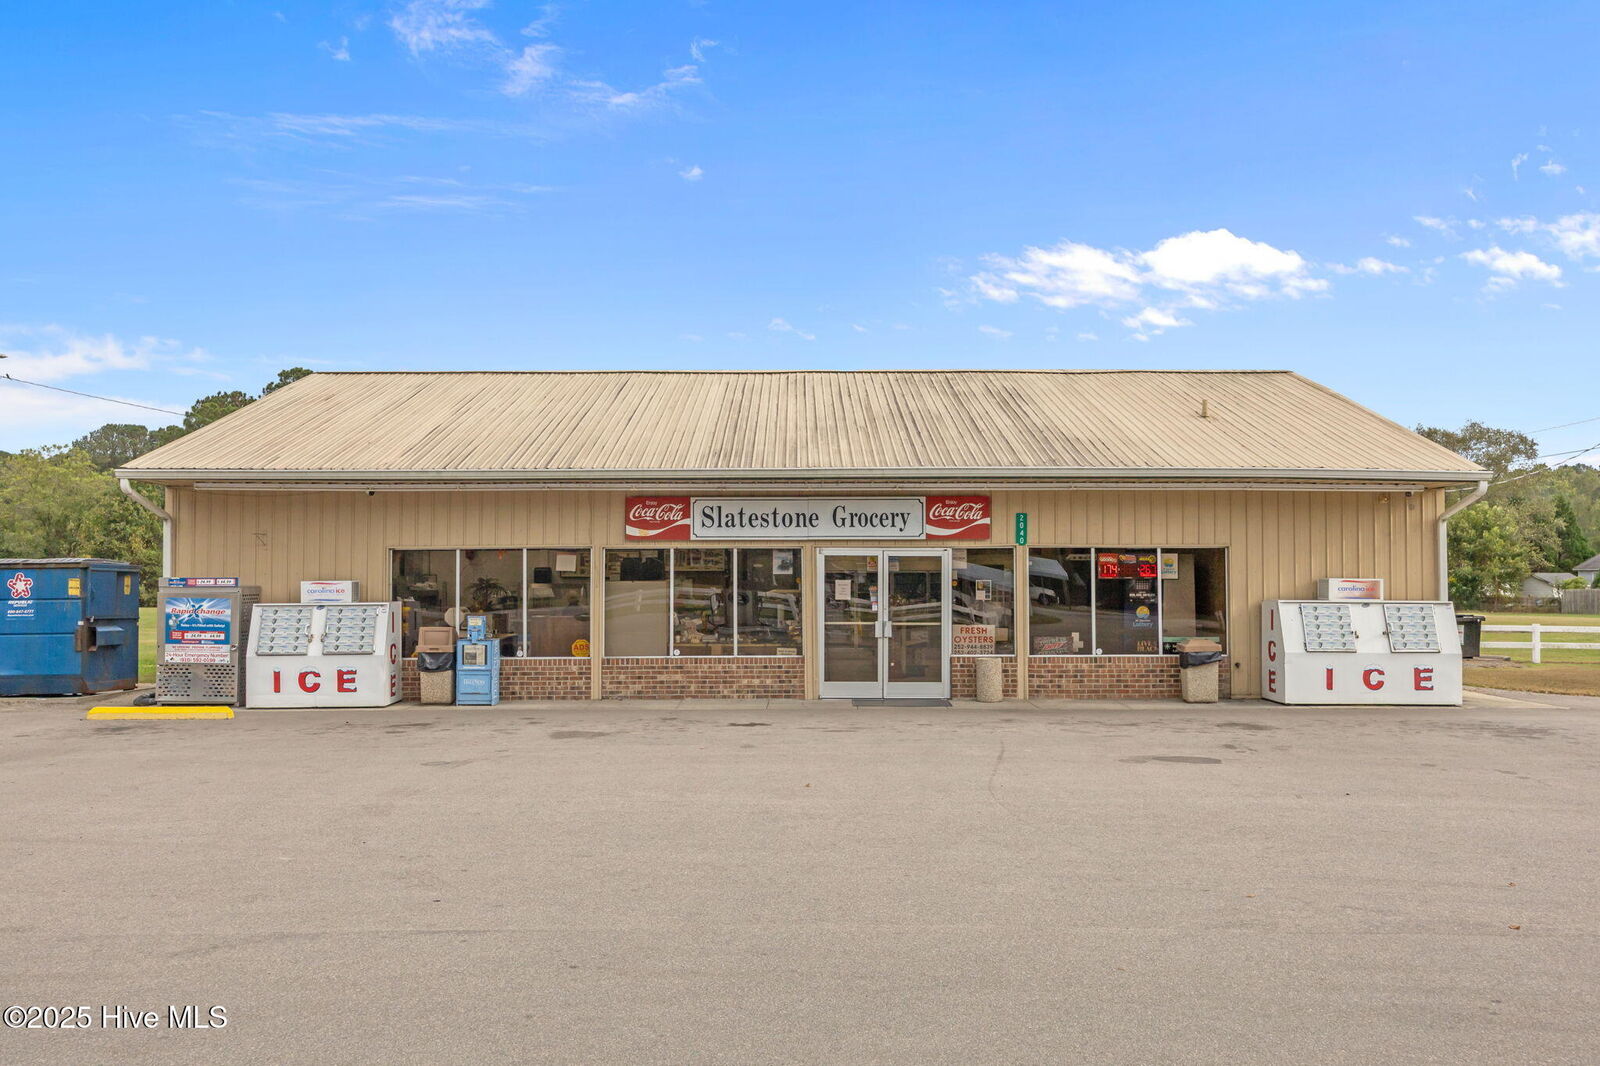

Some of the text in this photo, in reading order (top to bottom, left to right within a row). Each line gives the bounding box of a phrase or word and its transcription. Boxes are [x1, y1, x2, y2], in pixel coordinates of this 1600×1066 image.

[629, 504, 685, 521] Coca-Cola
[701, 505, 911, 532] Slatestone Grocery
[929, 503, 985, 520] Coca-Cola
[1337, 584, 1366, 592] carolina
[960, 626, 988, 635] FRESH
[953, 635, 994, 644] OYSTERS
[273, 666, 358, 693] ICE
[1326, 665, 1434, 691] ICE
